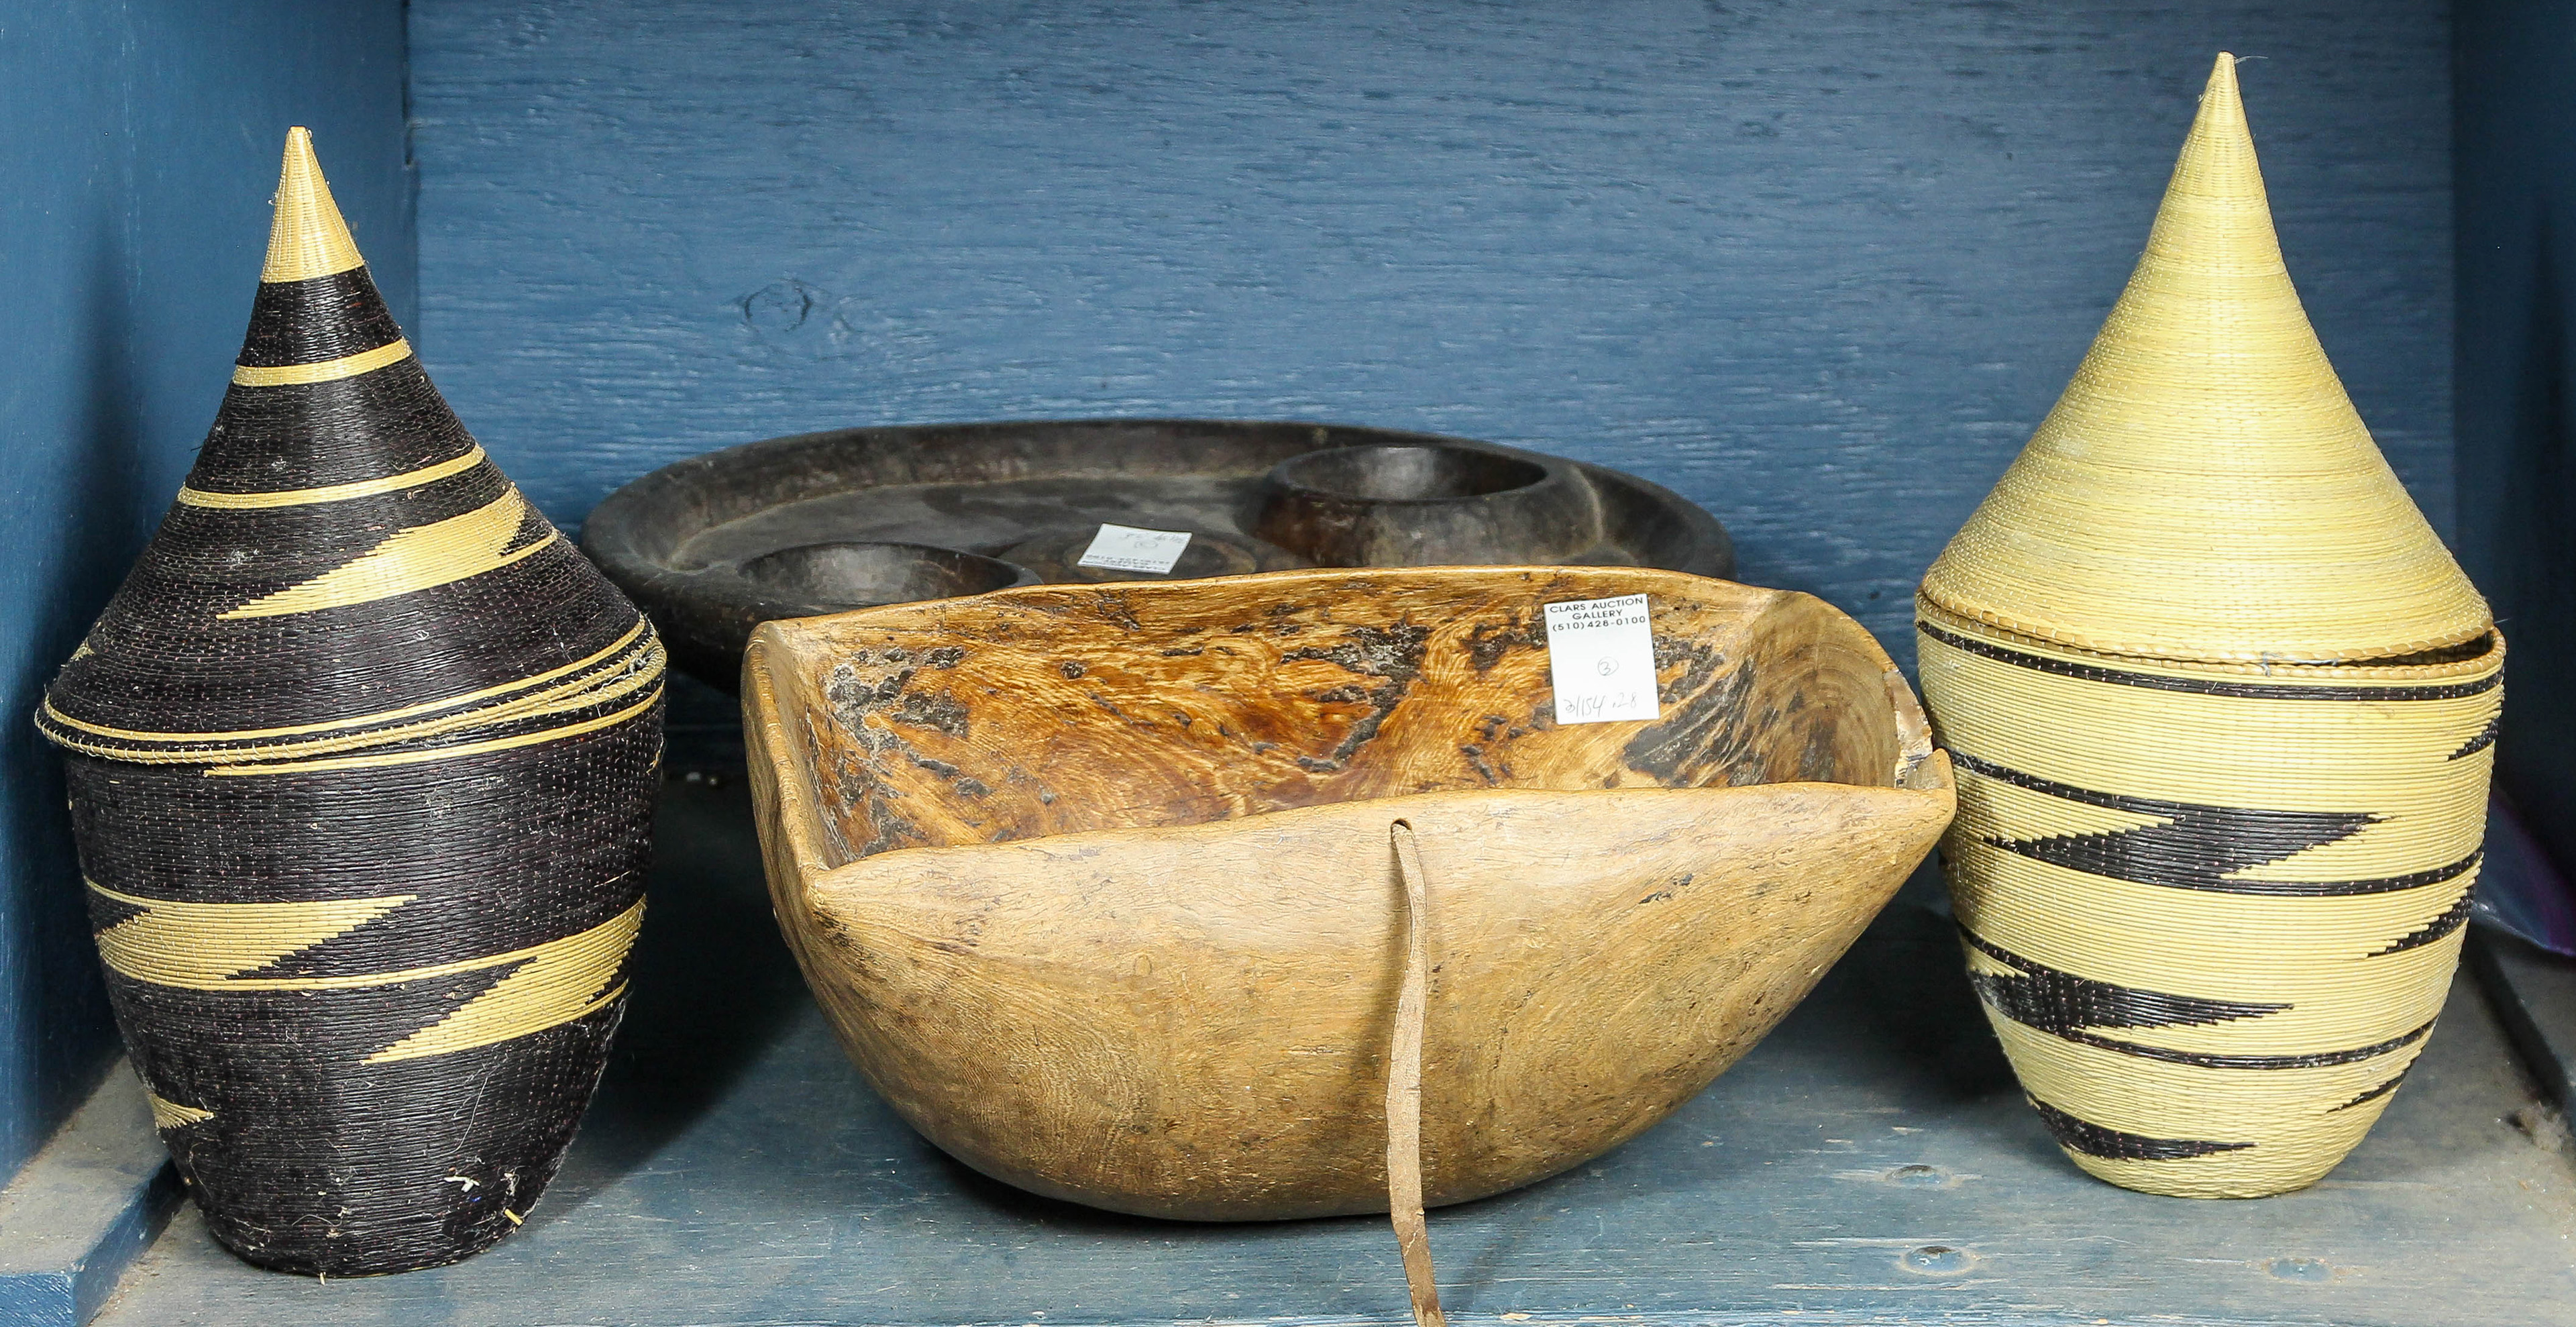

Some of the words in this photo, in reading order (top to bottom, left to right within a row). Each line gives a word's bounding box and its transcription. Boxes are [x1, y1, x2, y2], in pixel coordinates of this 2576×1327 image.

[1550, 604, 1586, 613] CLARS
[1591, 597, 1644, 610] AUCTION
[1572, 609, 1623, 620] GALLERY
[1552, 616, 1646, 632] (510)428-0100
